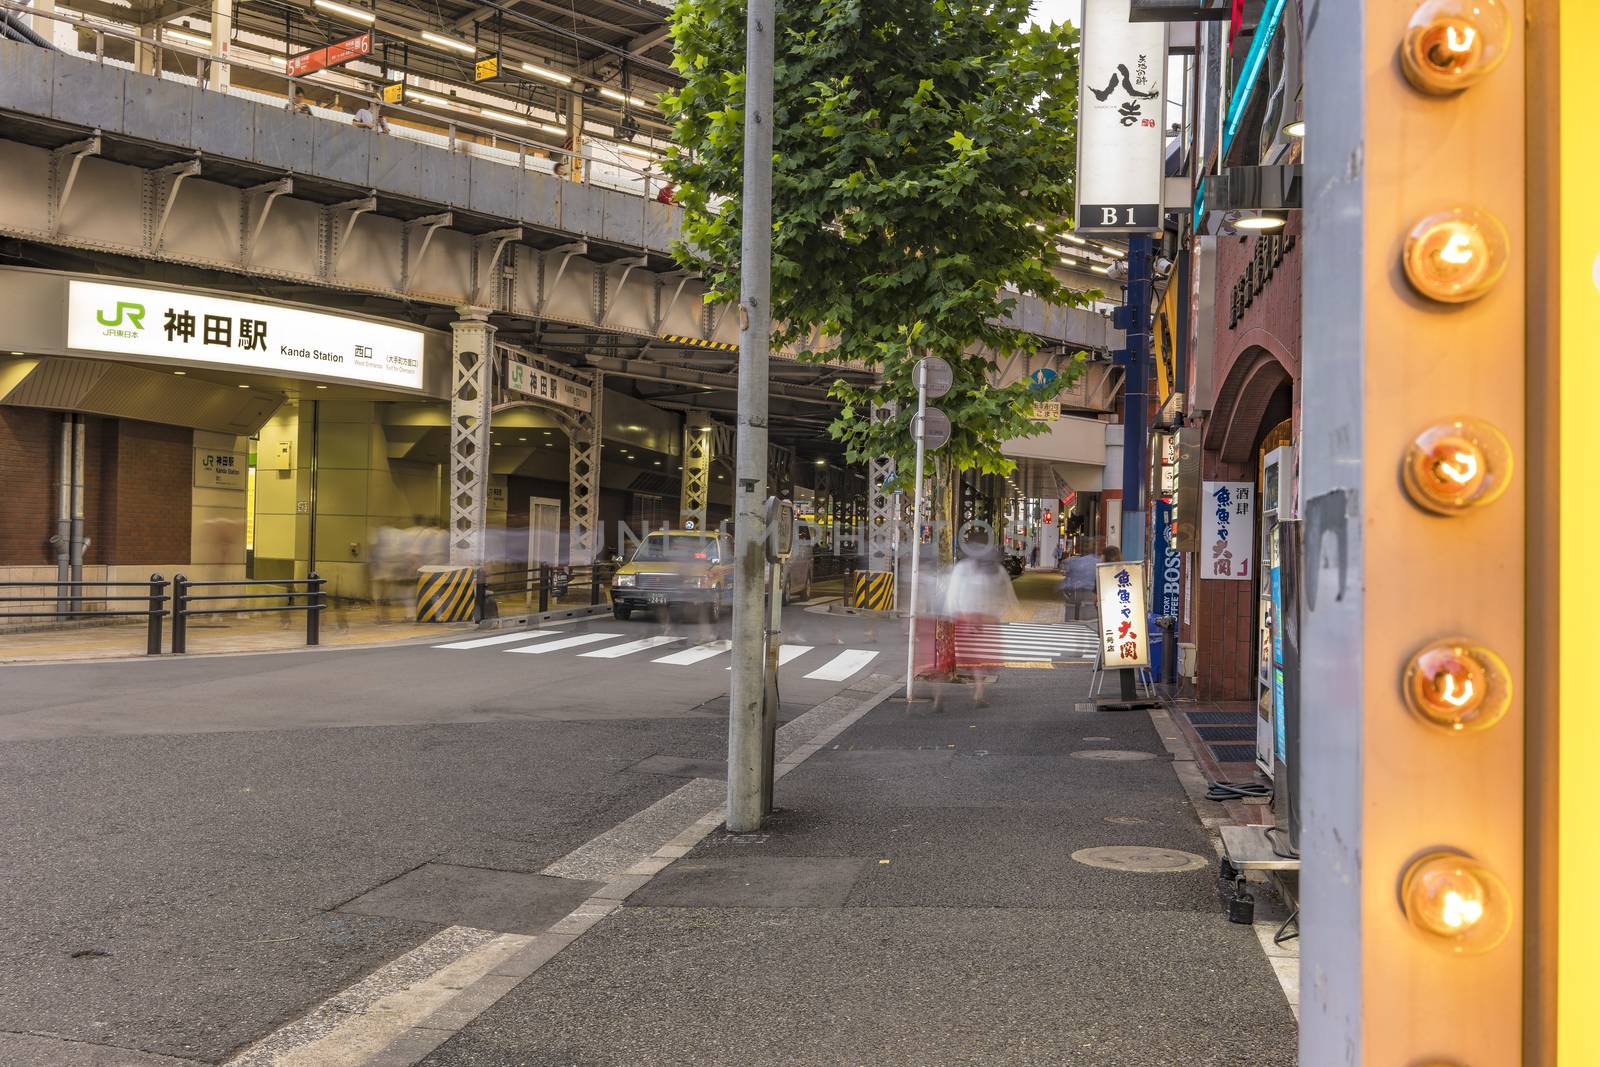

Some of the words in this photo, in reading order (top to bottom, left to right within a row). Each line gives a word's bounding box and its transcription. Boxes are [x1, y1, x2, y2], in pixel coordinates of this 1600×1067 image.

[96, 301, 146, 331] JR
[102, 328, 140, 339] JR東日本
[163, 307, 268, 352] 神田駅
[280, 345, 311, 359] Kanda
[313, 349, 344, 364] Station
[354, 344, 373, 359] 西口
[512, 365, 523, 384] JR
[530, 370, 557, 400] 神田駅
[203, 455, 214, 467] JR
[1163, 546, 1181, 595] BOSS
